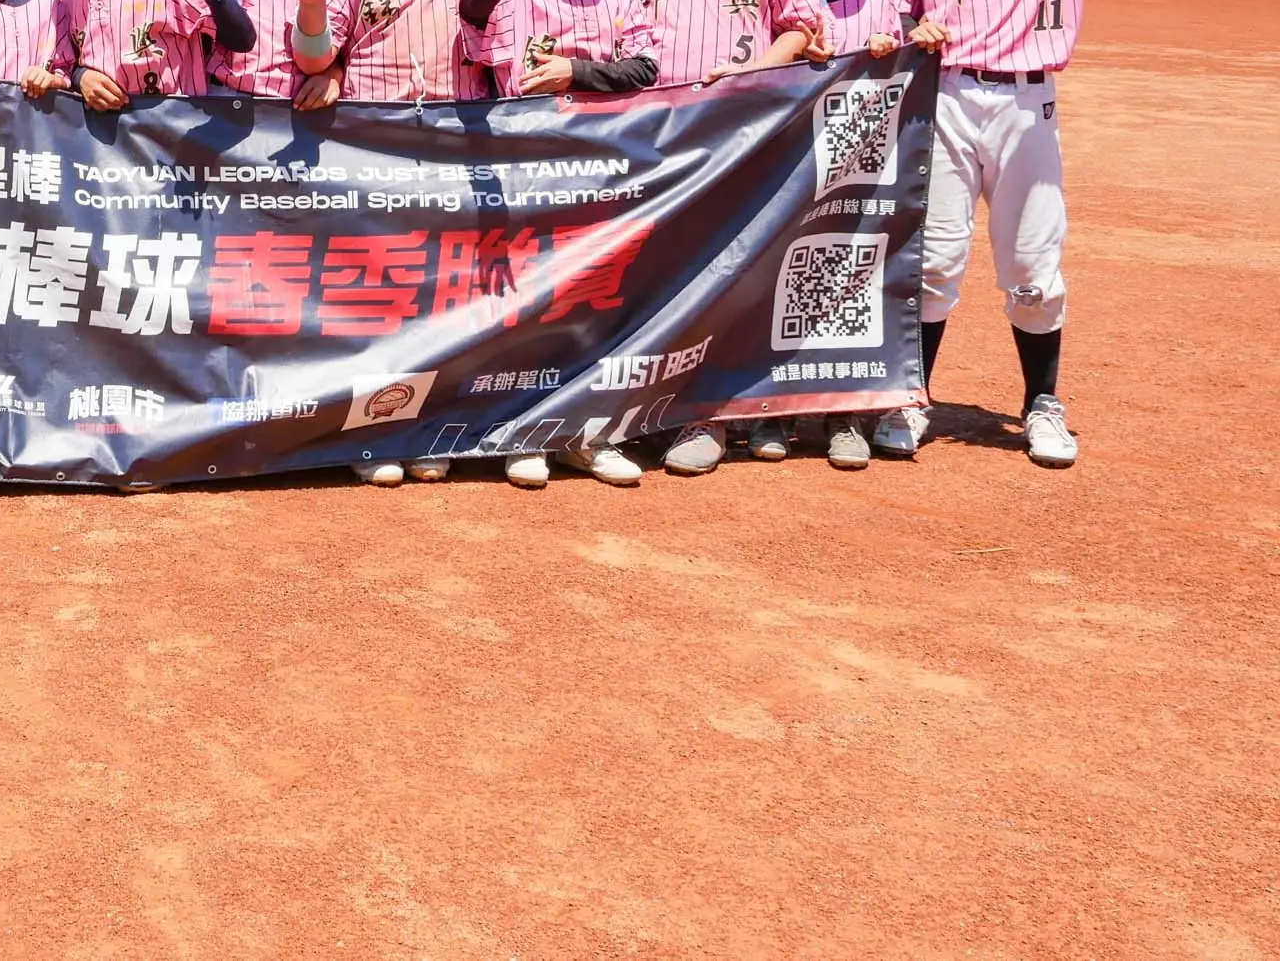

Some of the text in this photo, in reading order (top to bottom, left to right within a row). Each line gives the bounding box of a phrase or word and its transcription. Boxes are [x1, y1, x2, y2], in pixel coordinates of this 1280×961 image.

[1033, 0, 1064, 32] 11
[731, 34, 754, 65] 5
[73, 158, 631, 184] TAOYUAN LEOPARDS JUST BEST TAIWAN
[73, 182, 647, 215] Community Baseball Spring Tournament
[590, 335, 713, 391] JUST BEST
[770, 361, 887, 383] 就是棒賽事網站
[470, 368, 561, 393] 承辦單位
[67, 384, 166, 422] 桃園市
